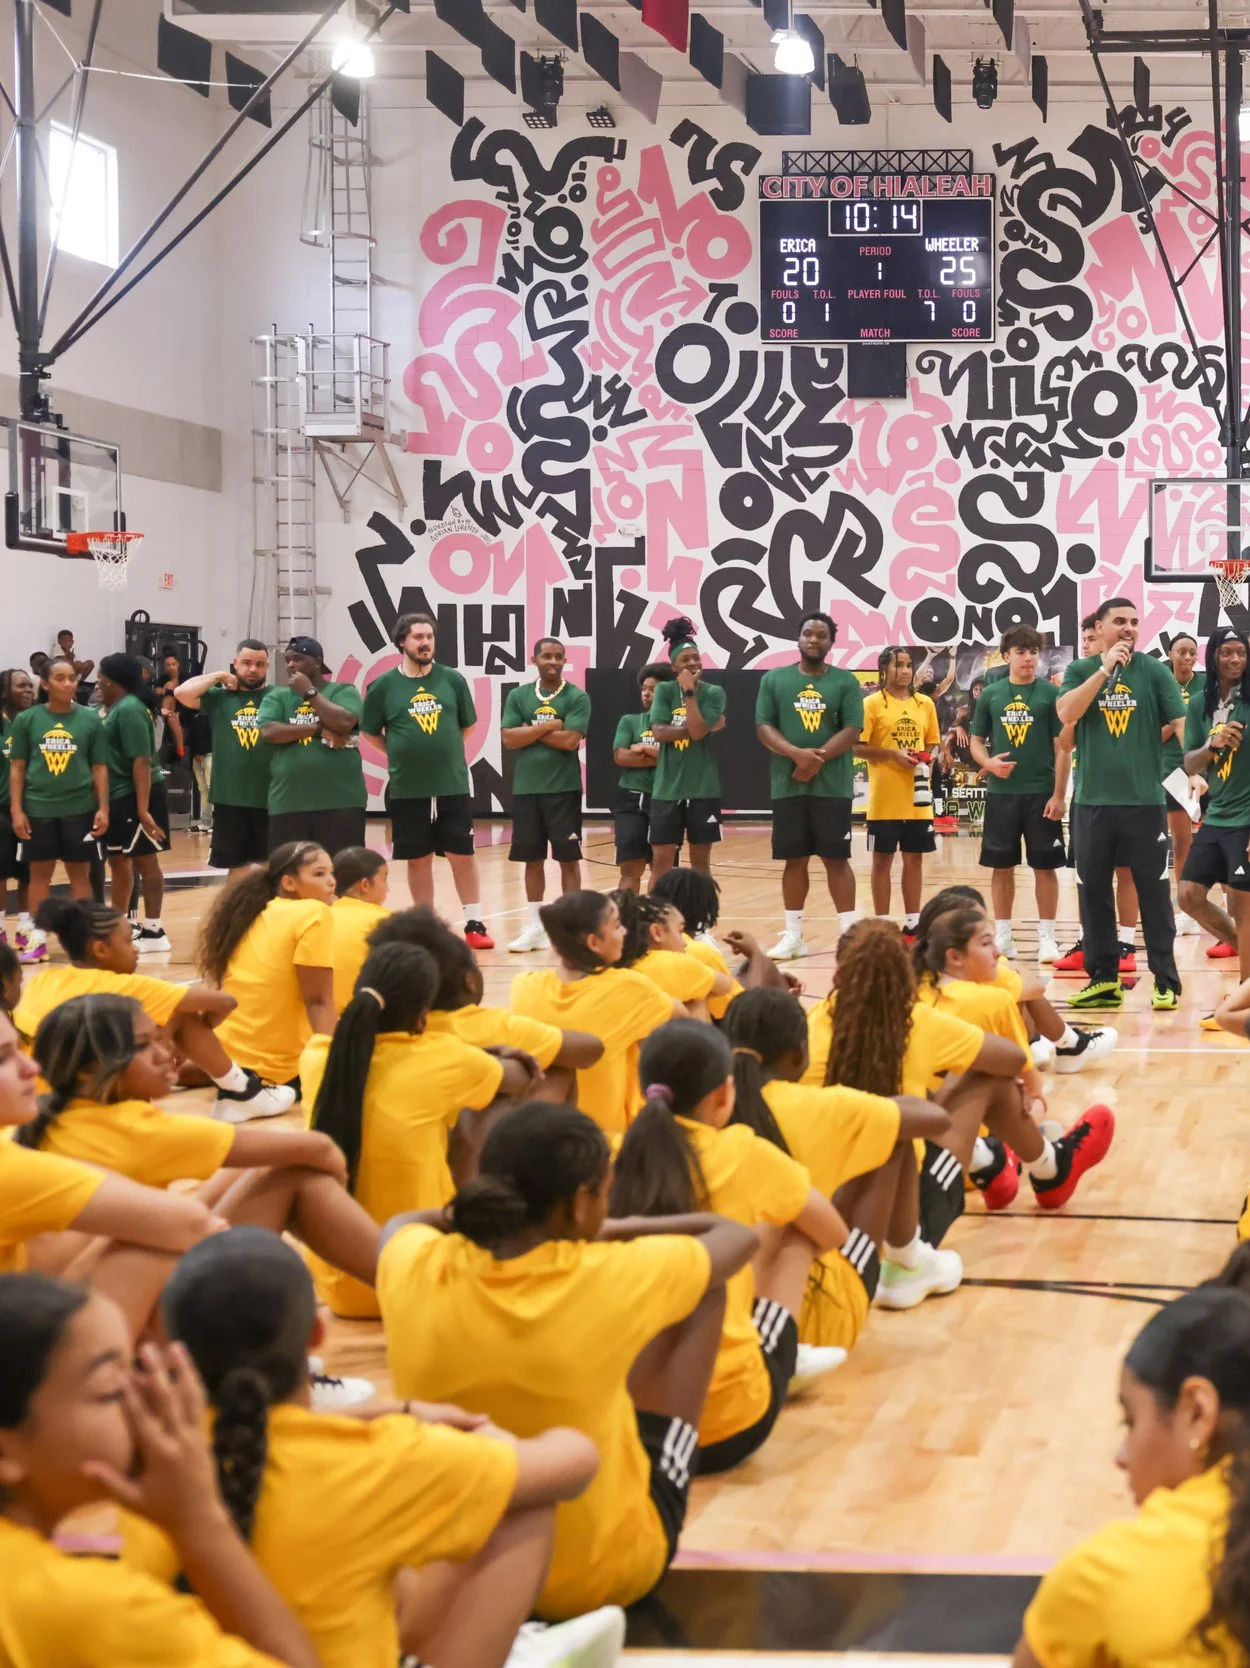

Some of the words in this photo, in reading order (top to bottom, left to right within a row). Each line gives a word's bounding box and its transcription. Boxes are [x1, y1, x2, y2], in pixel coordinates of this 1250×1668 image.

[762, 175, 826, 198] CITY
[830, 175, 868, 198] OF
[873, 174, 991, 197] HIALEAH
[845, 203, 917, 231] 10:14
[780, 238, 816, 253] ERICA
[859, 246, 892, 256] PERIOD
[925, 237, 979, 252] WHEELER
[783, 257, 819, 286] 20
[877, 262, 882, 280] 1
[940, 256, 976, 285] 25
[771, 289, 799, 299] FOULS
[813, 289, 836, 299] T.O.L.
[848, 289, 881, 298] PLAYER
[883, 289, 907, 298] FOUL
[918, 289, 940, 298] T.O.L.
[952, 288, 980, 298] FOULS
[783, 302, 796, 323] 0
[825, 303, 830, 322] 1
[924, 301, 935, 321] 7
[963, 301, 976, 322] 0
[769, 329, 799, 338] SCORE
[860, 328, 891, 338] MATCH
[951, 328, 981, 337] SCORE
